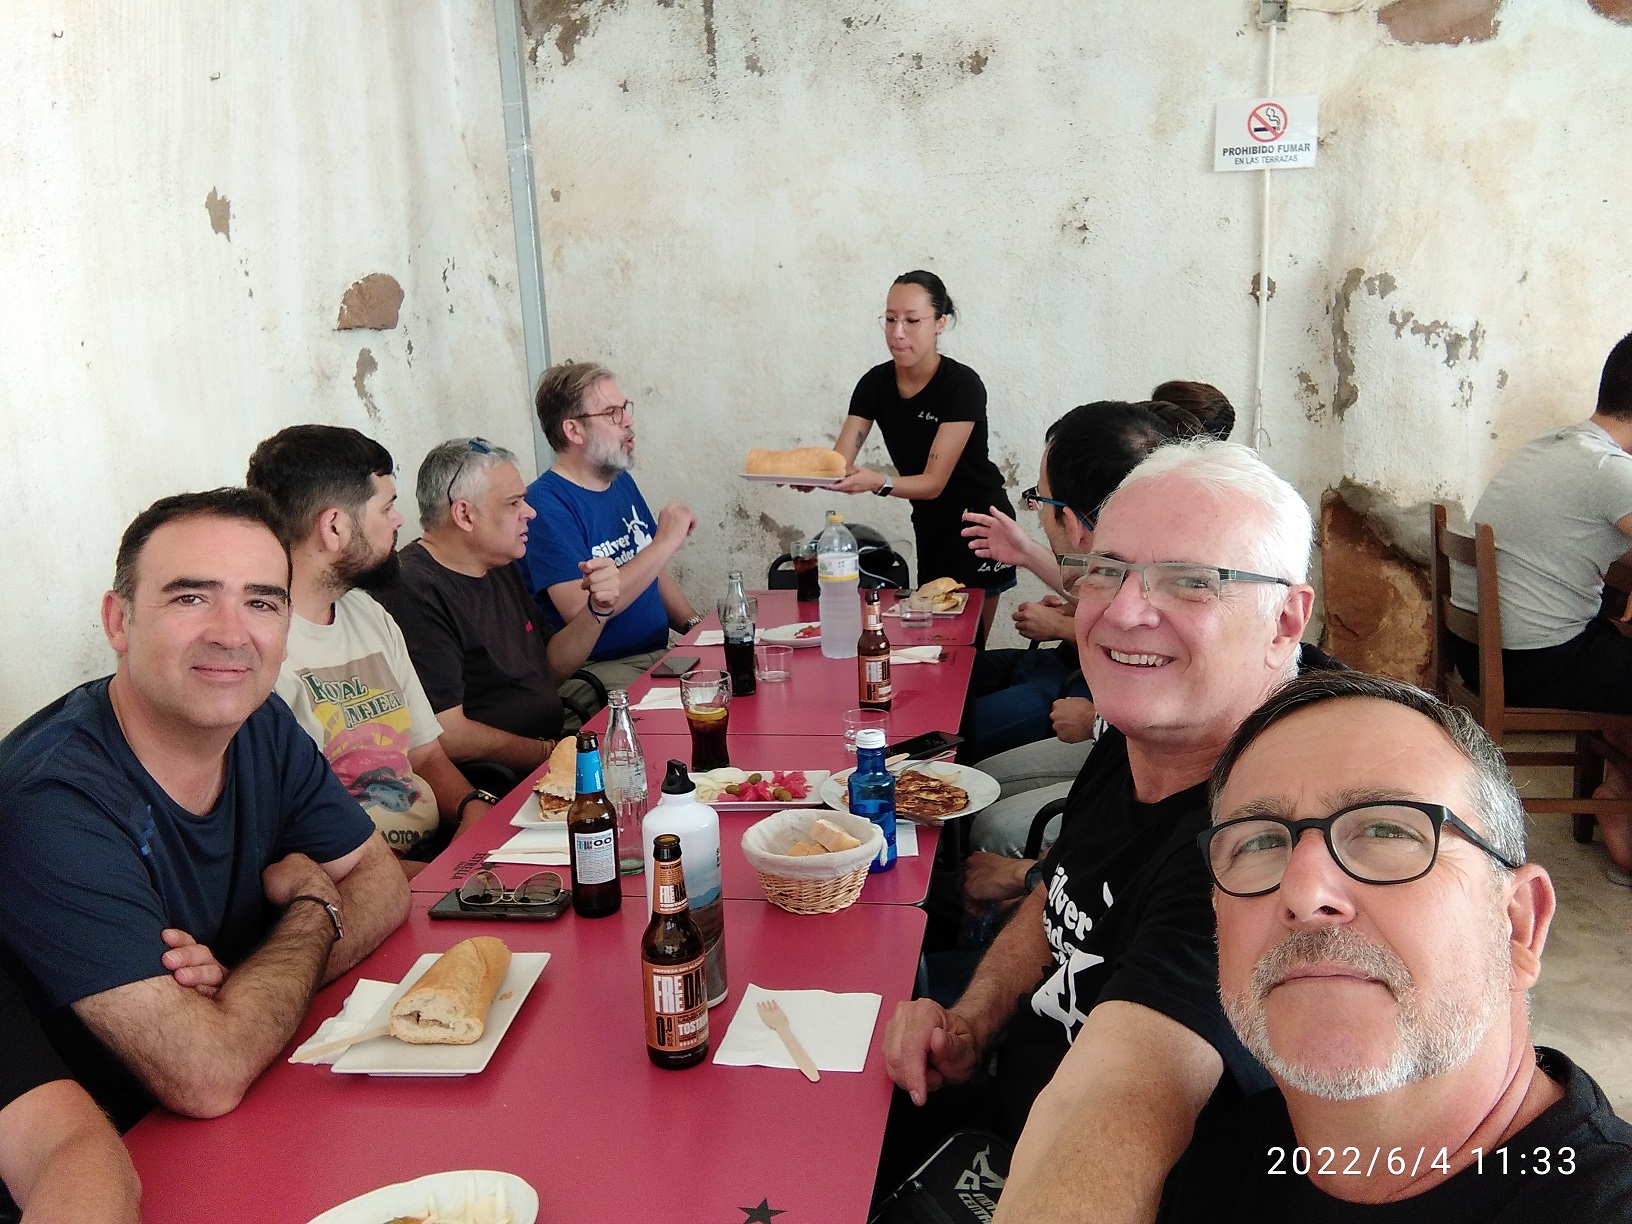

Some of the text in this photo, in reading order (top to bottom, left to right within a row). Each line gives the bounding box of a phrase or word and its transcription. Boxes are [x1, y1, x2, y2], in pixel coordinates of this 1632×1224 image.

[1222, 143, 1311, 157] PROHIBIDO FUMAR
[1234, 155, 1298, 165] EN LAS TERRAZAS
[591, 534, 631, 559] Silver
[1048, 863, 1093, 941] ilver
